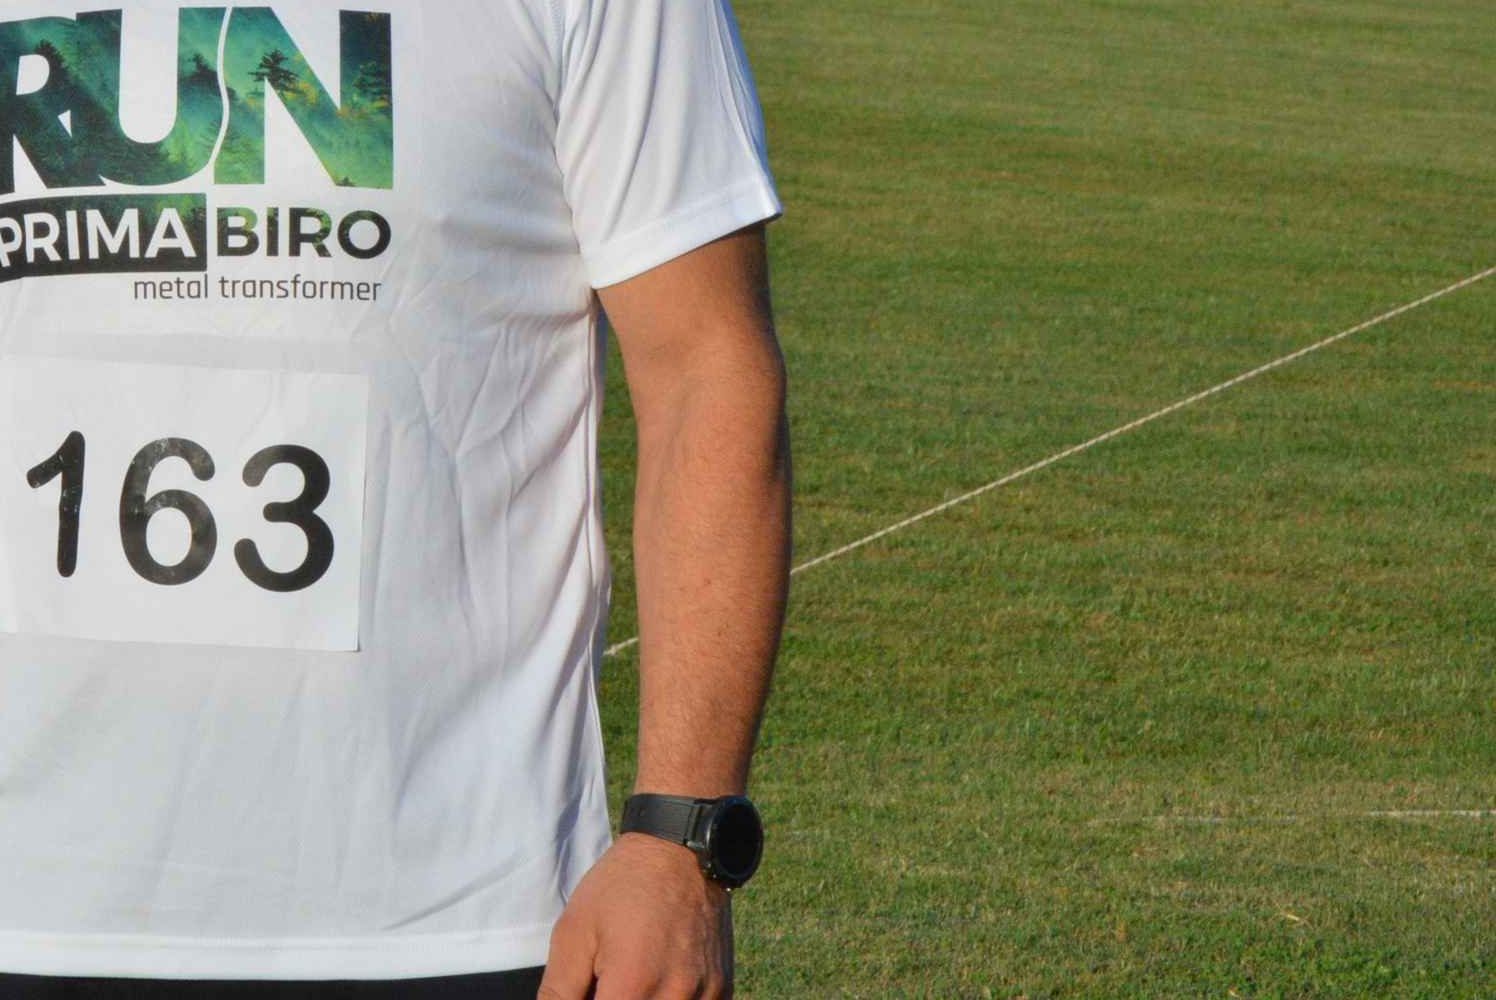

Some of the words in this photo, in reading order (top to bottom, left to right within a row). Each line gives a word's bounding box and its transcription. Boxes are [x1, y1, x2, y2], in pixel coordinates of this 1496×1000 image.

[216, 206, 392, 260] BIRO
[133, 274, 209, 301] metal
[219, 273, 382, 301] transformer
[26, 430, 336, 593] 163
